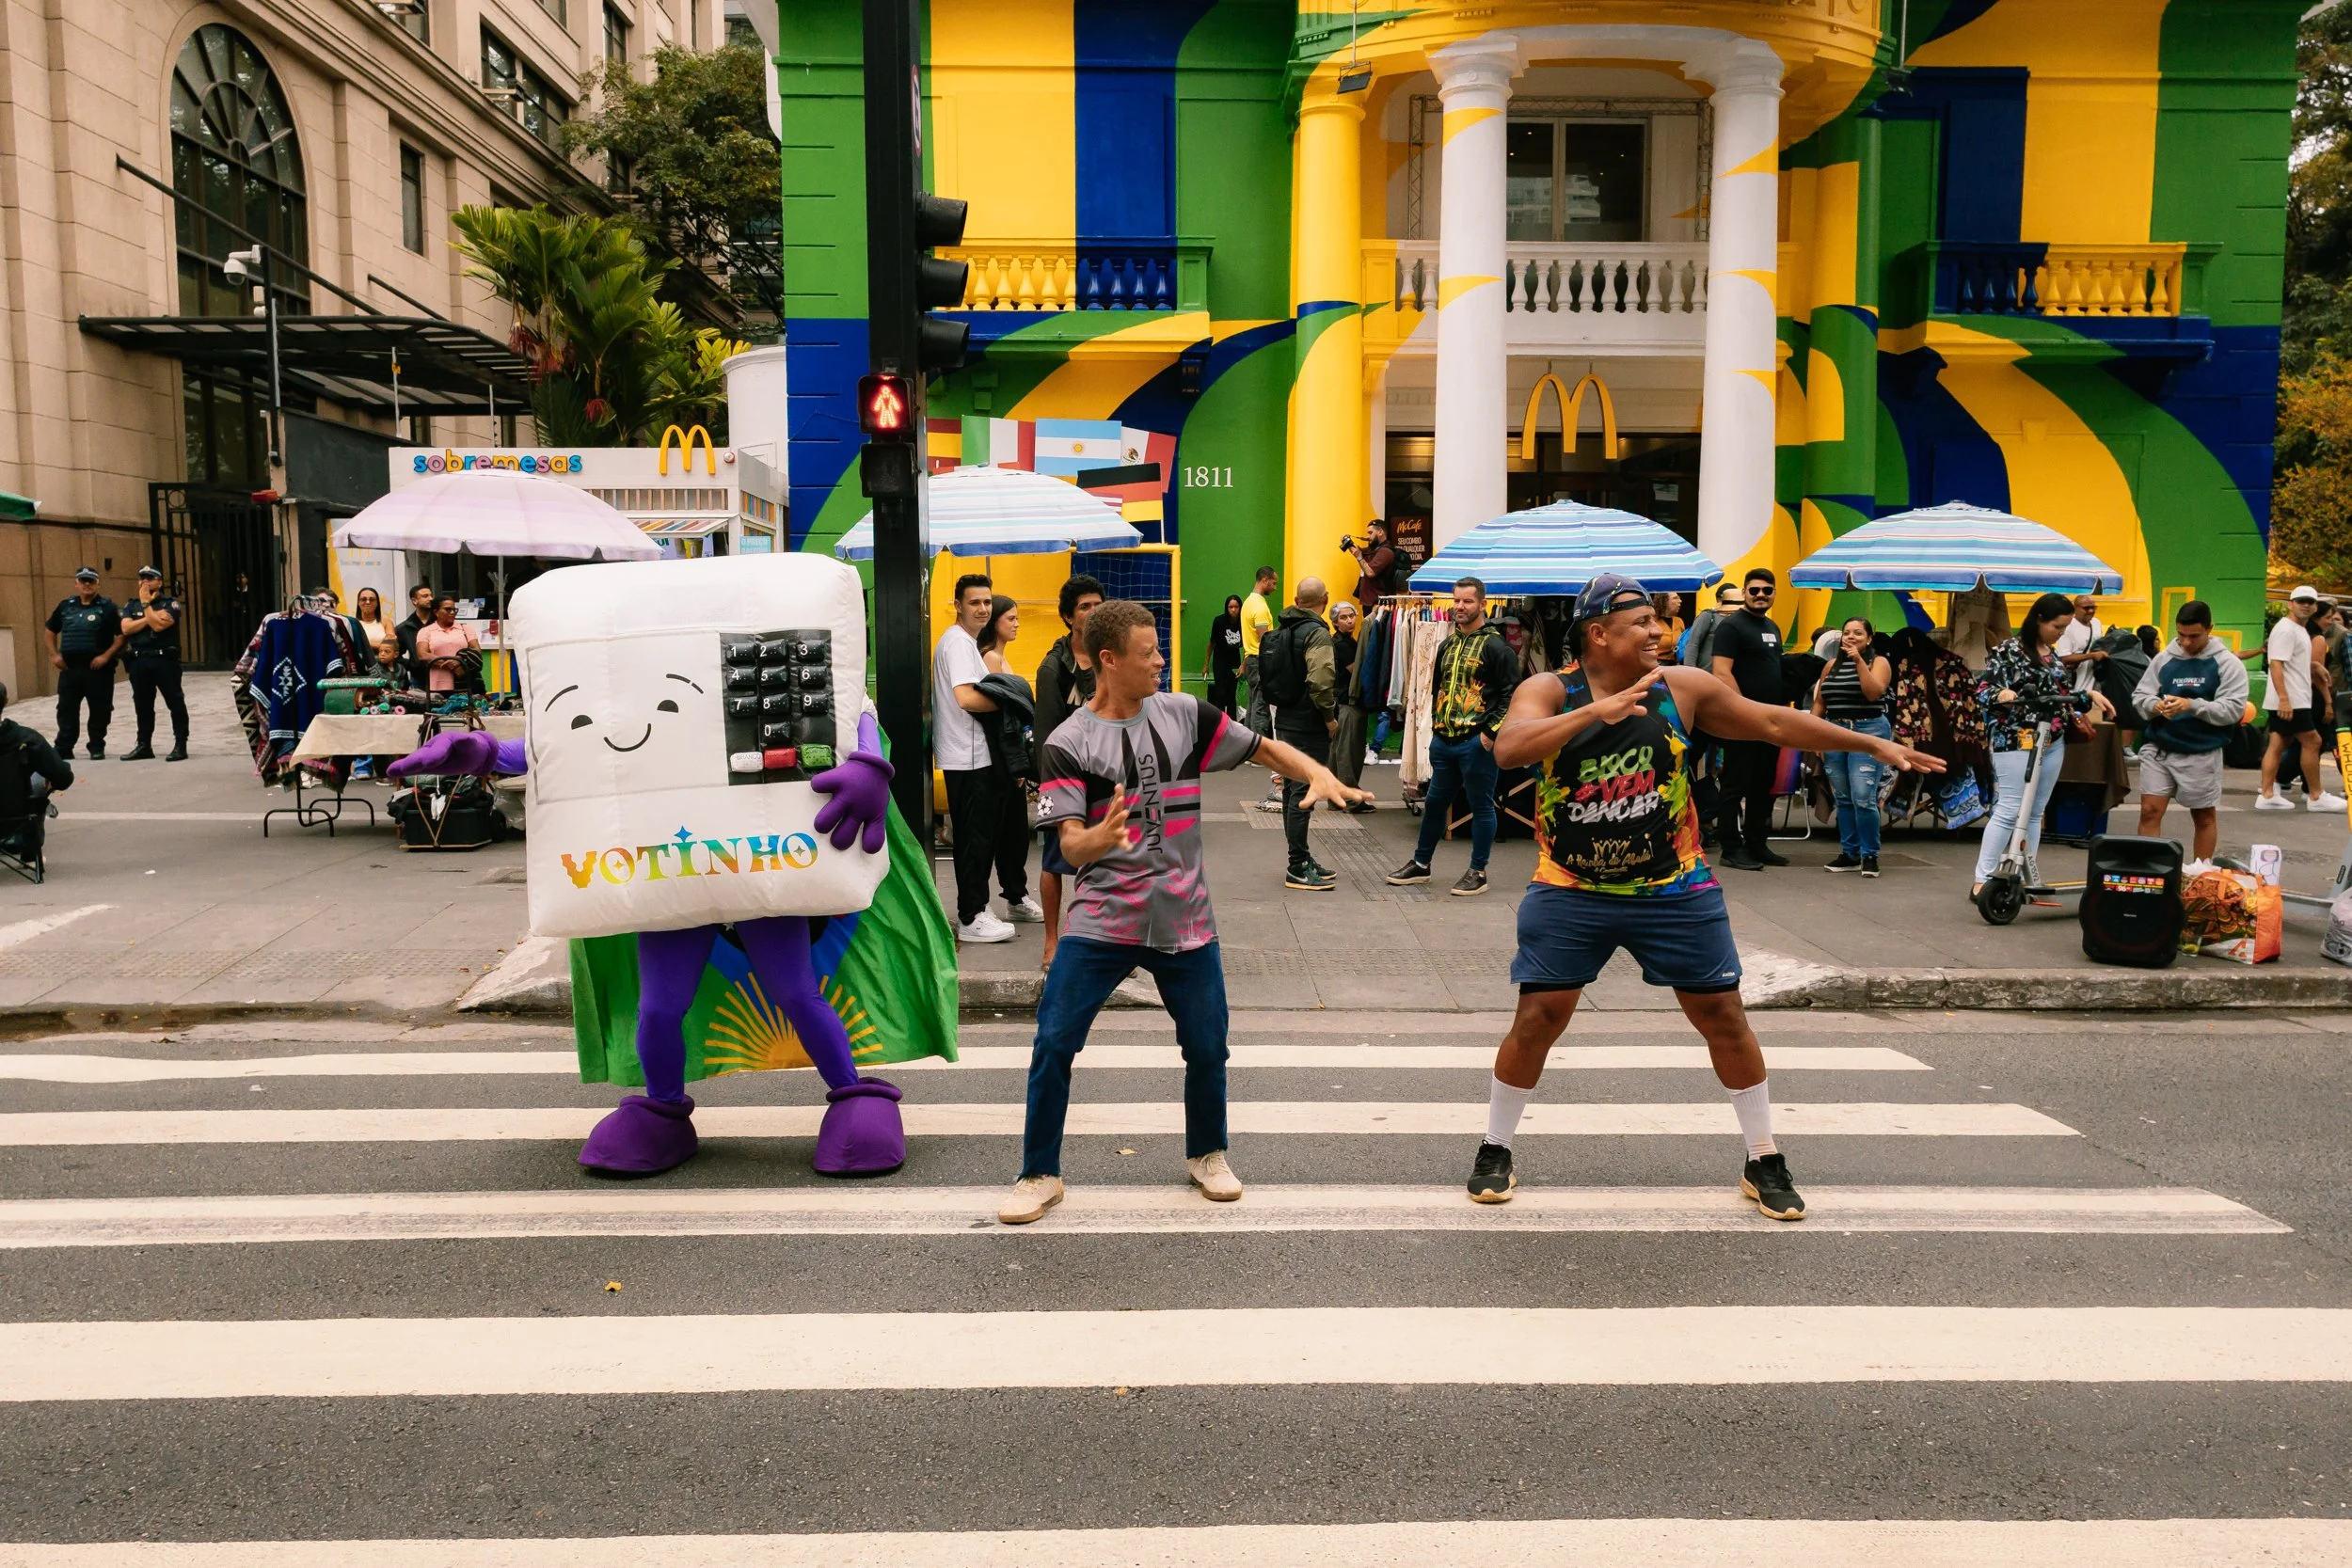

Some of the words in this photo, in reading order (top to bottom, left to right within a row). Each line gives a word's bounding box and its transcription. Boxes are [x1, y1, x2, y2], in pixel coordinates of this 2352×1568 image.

[414, 449, 583, 473] sobremesas
[1184, 466, 1234, 488] 1811
[1397, 519, 1422, 533] McCafé
[731, 645, 737, 657] 1
[759, 645, 768, 657] 2
[800, 643, 808, 656] 3
[731, 669, 740, 681] 4
[760, 670, 769, 682] 5
[802, 668, 810, 680] 6
[734, 699, 742, 710] 7
[763, 697, 771, 710] 8
[803, 694, 812, 706] 9
[764, 724, 771, 736] 0
[1577, 746, 1654, 783] BLOCO
[1574, 768, 1656, 804] #VEM
[1137, 753, 1163, 854] JUVENTUS
[561, 825, 818, 889] VOTINHO
